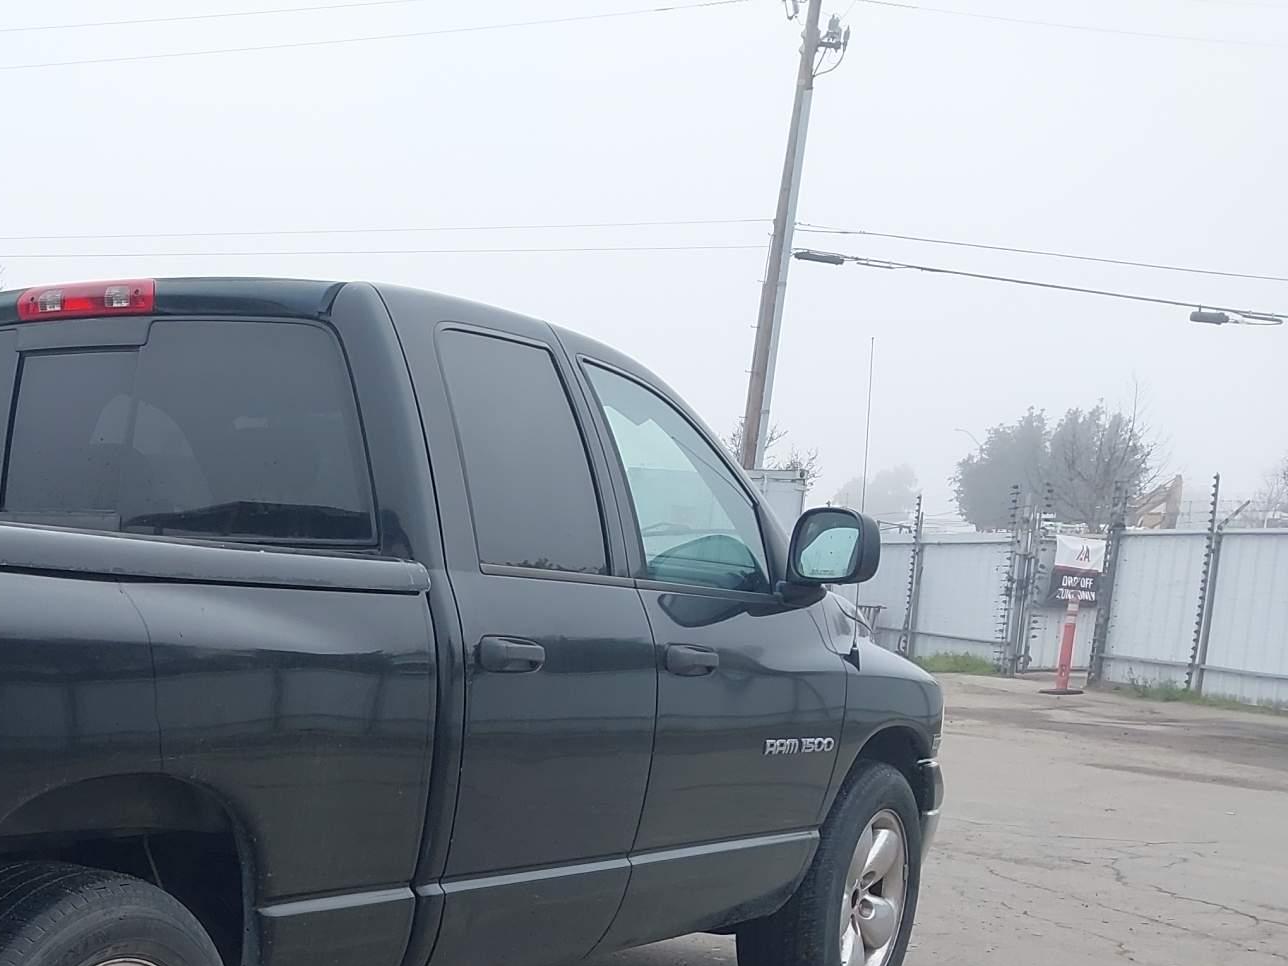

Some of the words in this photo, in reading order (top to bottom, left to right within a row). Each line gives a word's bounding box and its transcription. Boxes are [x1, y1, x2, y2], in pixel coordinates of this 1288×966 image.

[1080, 577, 1094, 589] OFF
[764, 739, 799, 755] RAM
[800, 737, 834, 752] 1500
